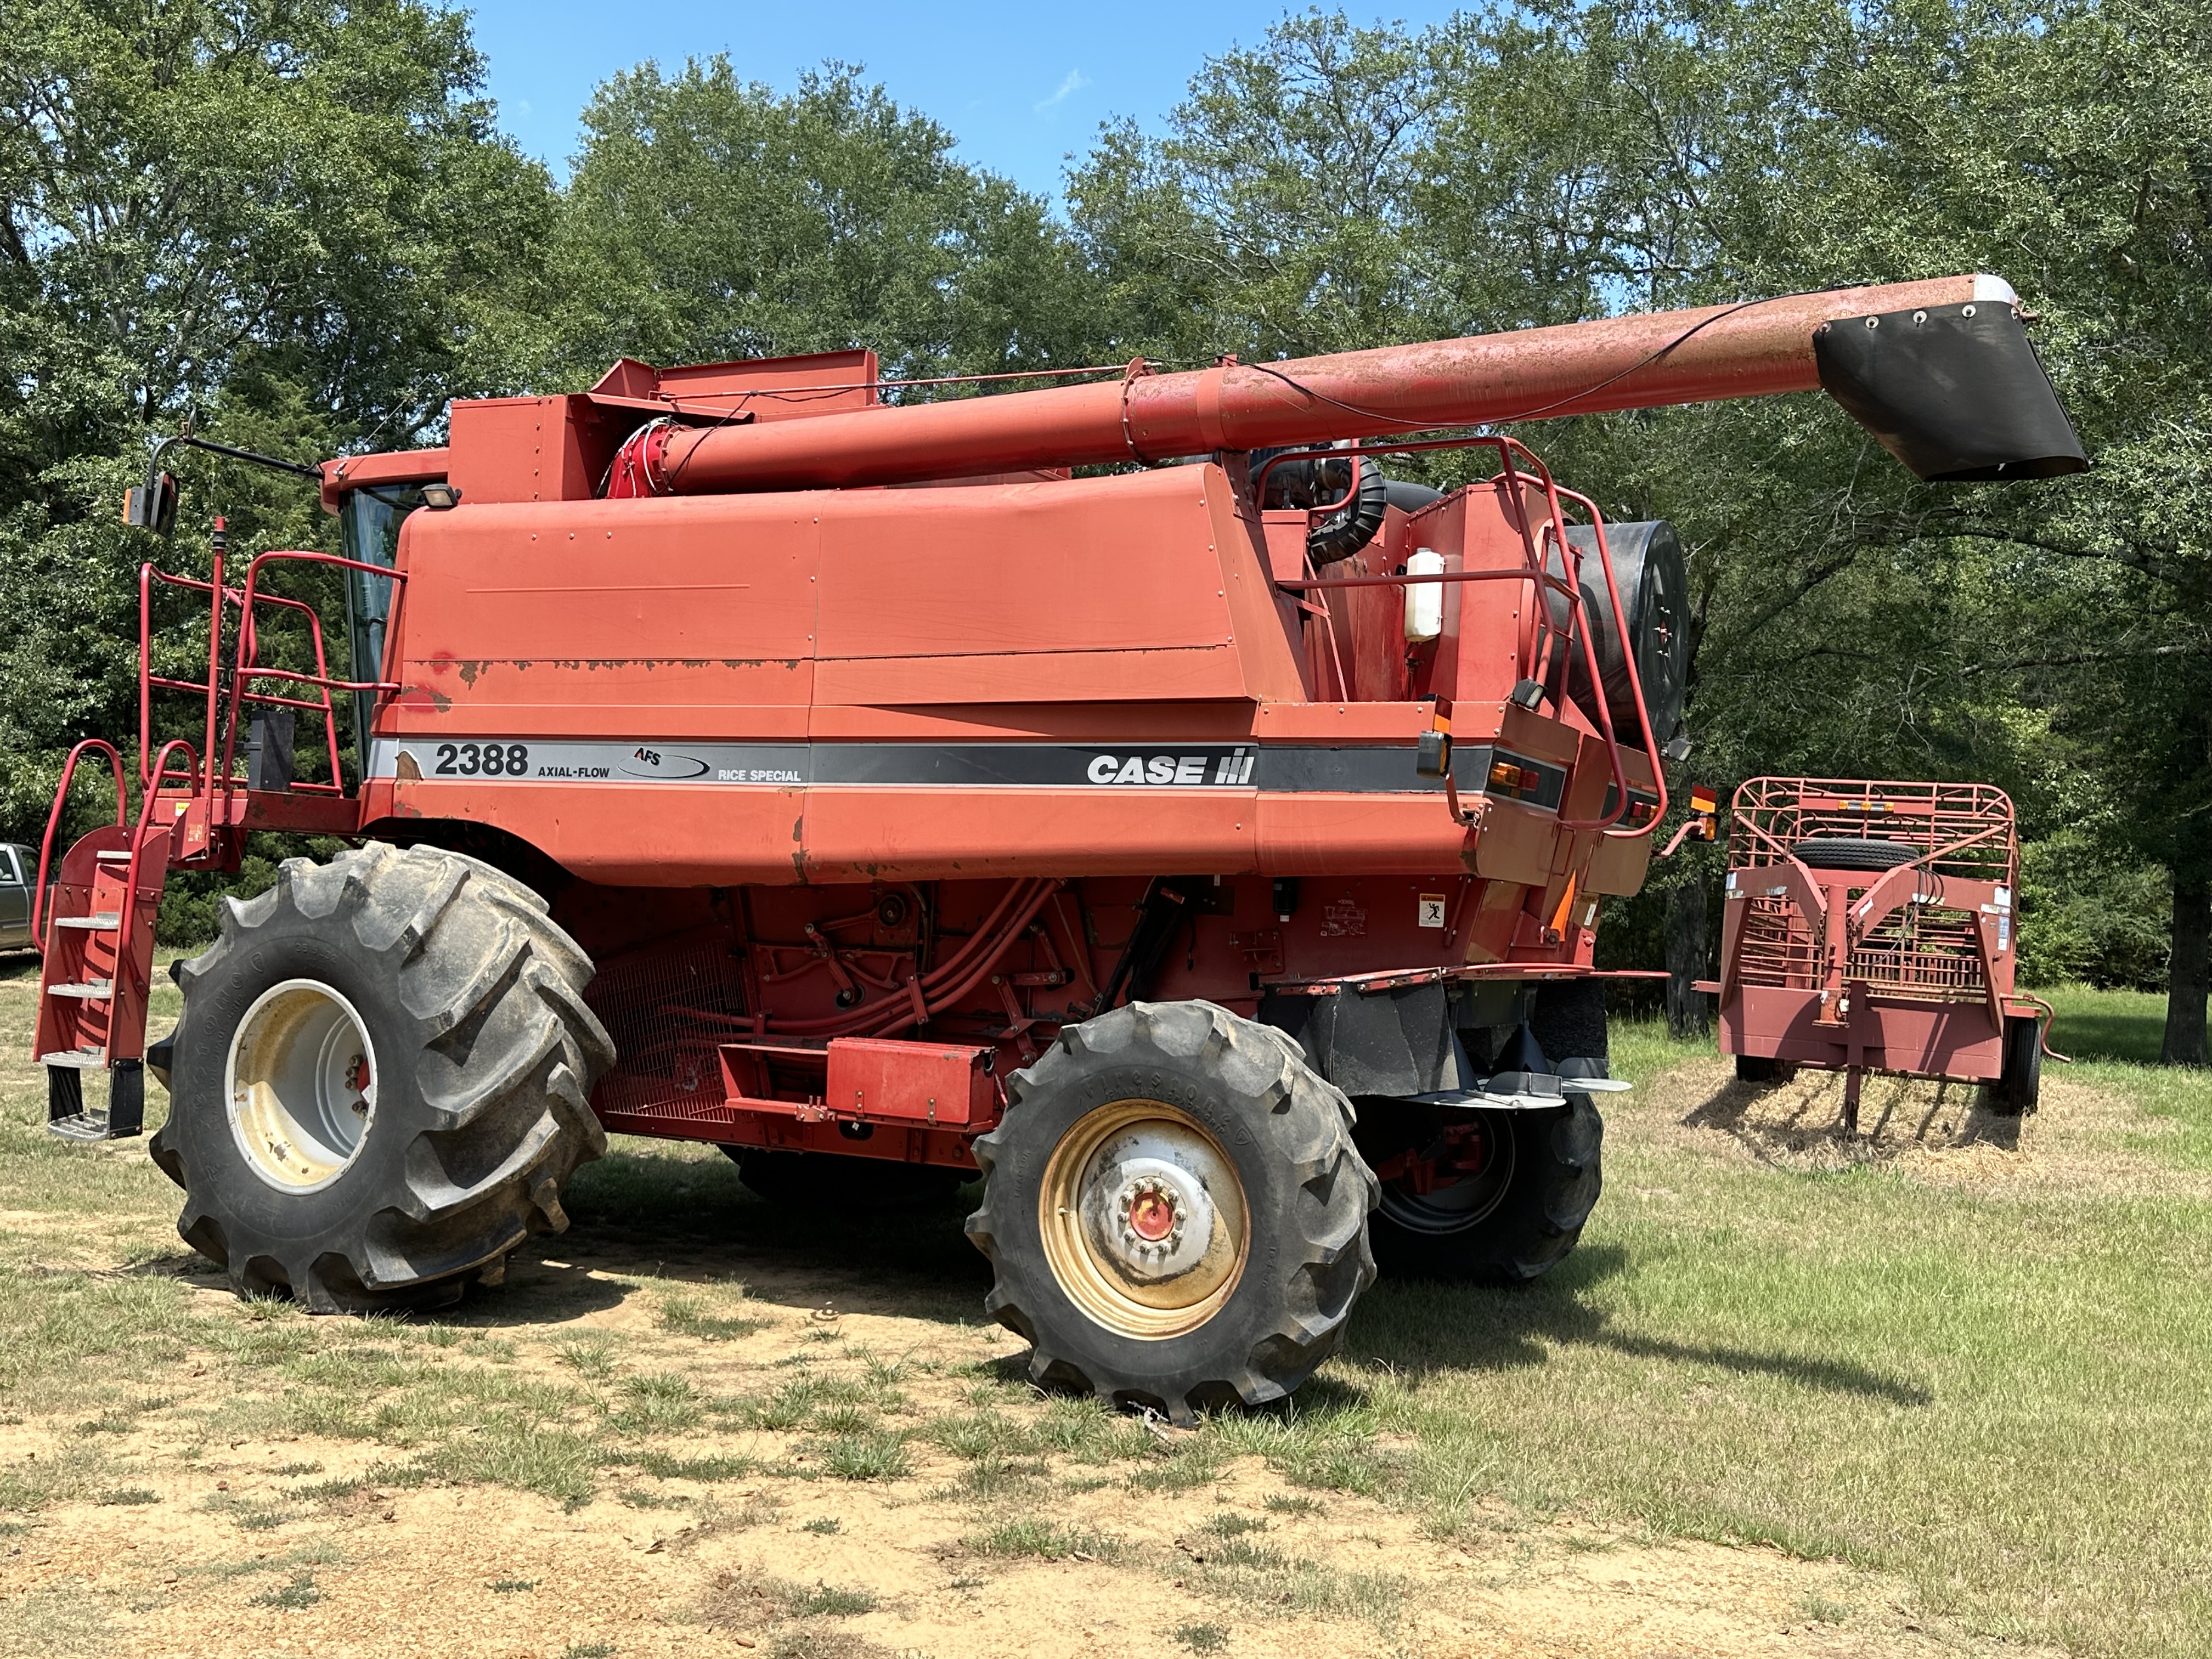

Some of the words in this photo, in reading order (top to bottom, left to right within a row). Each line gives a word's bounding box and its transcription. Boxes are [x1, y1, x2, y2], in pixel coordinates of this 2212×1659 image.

[435, 743, 528, 776] 2388
[538, 767, 610, 778] AXIAL-FLOW
[634, 747, 661, 766] AFS
[1087, 755, 1207, 784] CASE
[718, 770, 746, 780] RICE
[750, 770, 801, 782] SPECIAL
[1014, 1150, 1031, 1199] TRACTOR
